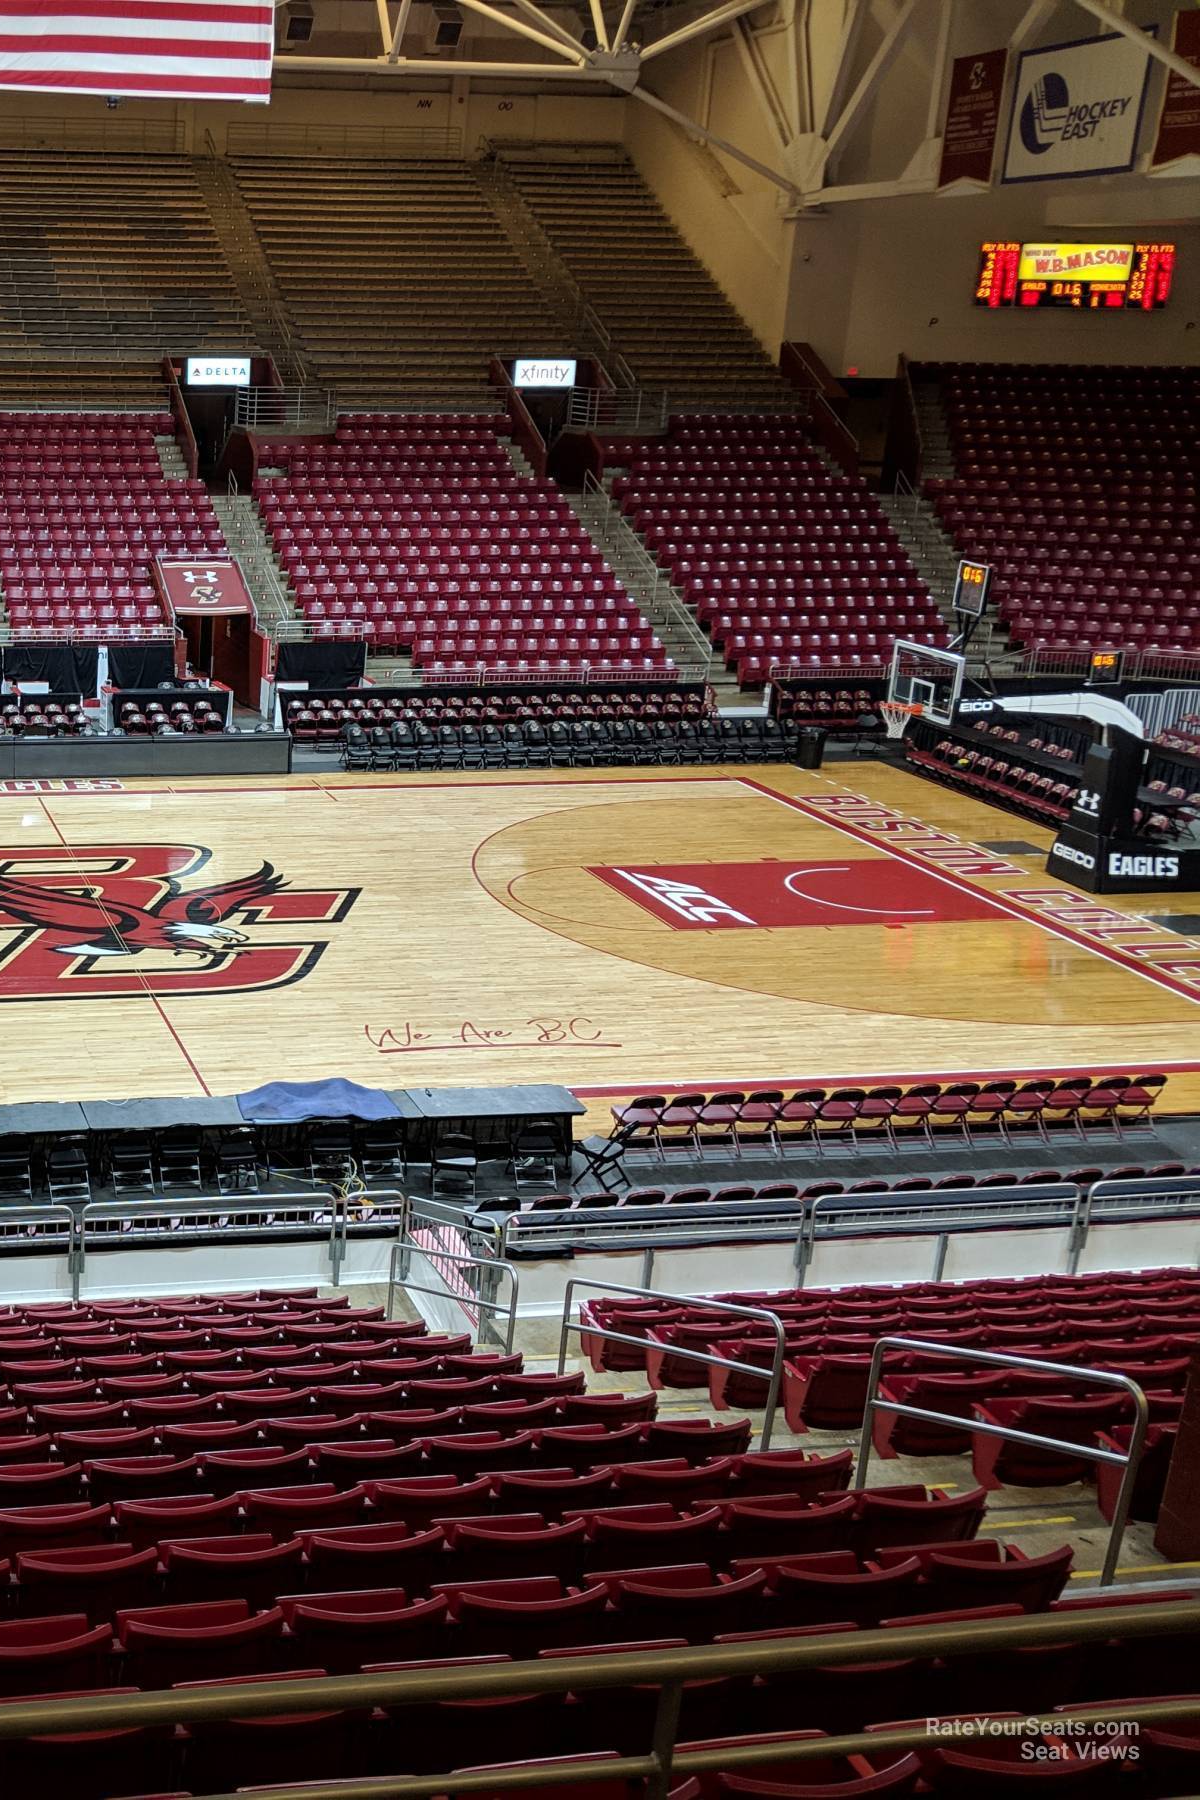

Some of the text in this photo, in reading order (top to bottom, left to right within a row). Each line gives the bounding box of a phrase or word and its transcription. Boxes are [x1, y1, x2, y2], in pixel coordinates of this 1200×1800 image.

[1065, 96, 1133, 123] HOCKEY
[1060, 120, 1100, 142] EAST
[977, 288, 991, 298] 23
[206, 367, 247, 376] DELTA
[520, 365, 570, 382] xfinity
[959, 701, 993, 712] EICO
[794, 794, 1030, 877] BOSTON
[1052, 842, 1096, 870] GEICO
[1108, 852, 1180, 877] EAGLES
[630, 871, 760, 926] ACC
[364, 1017, 603, 1048] We Are BC
